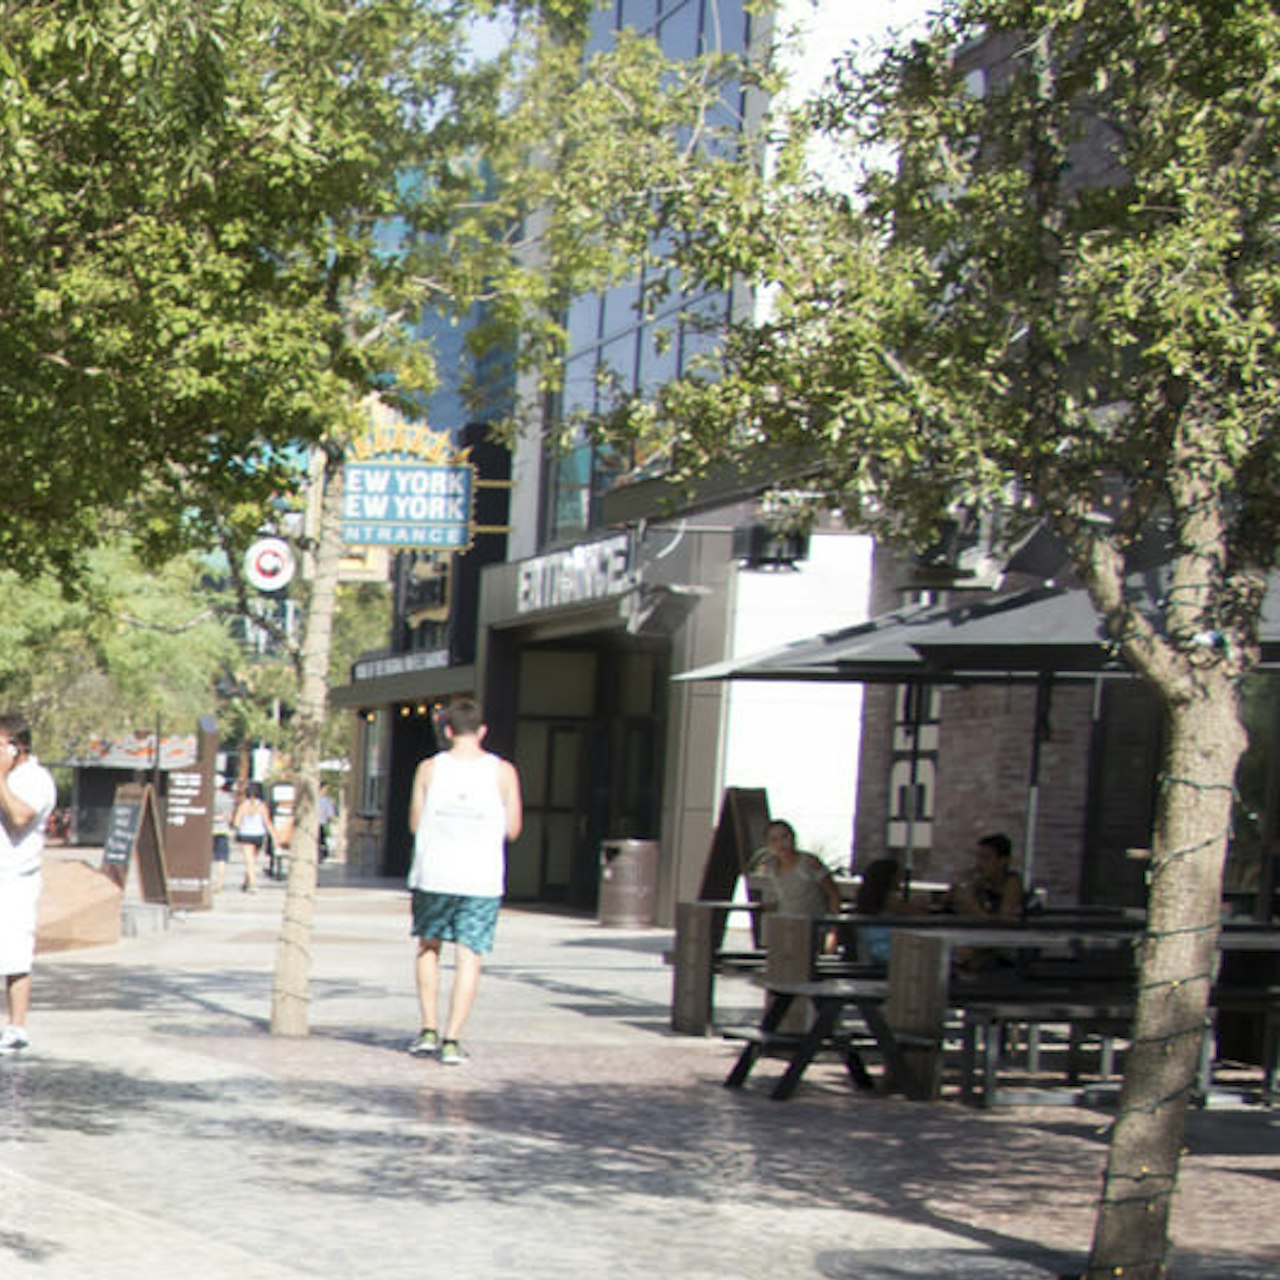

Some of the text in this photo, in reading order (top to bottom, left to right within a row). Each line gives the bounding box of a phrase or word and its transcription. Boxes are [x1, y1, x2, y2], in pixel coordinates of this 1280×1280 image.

[346, 469, 465, 495] EW YORK
[344, 494, 464, 520] EW YORK
[343, 526, 461, 543] NTRANCE
